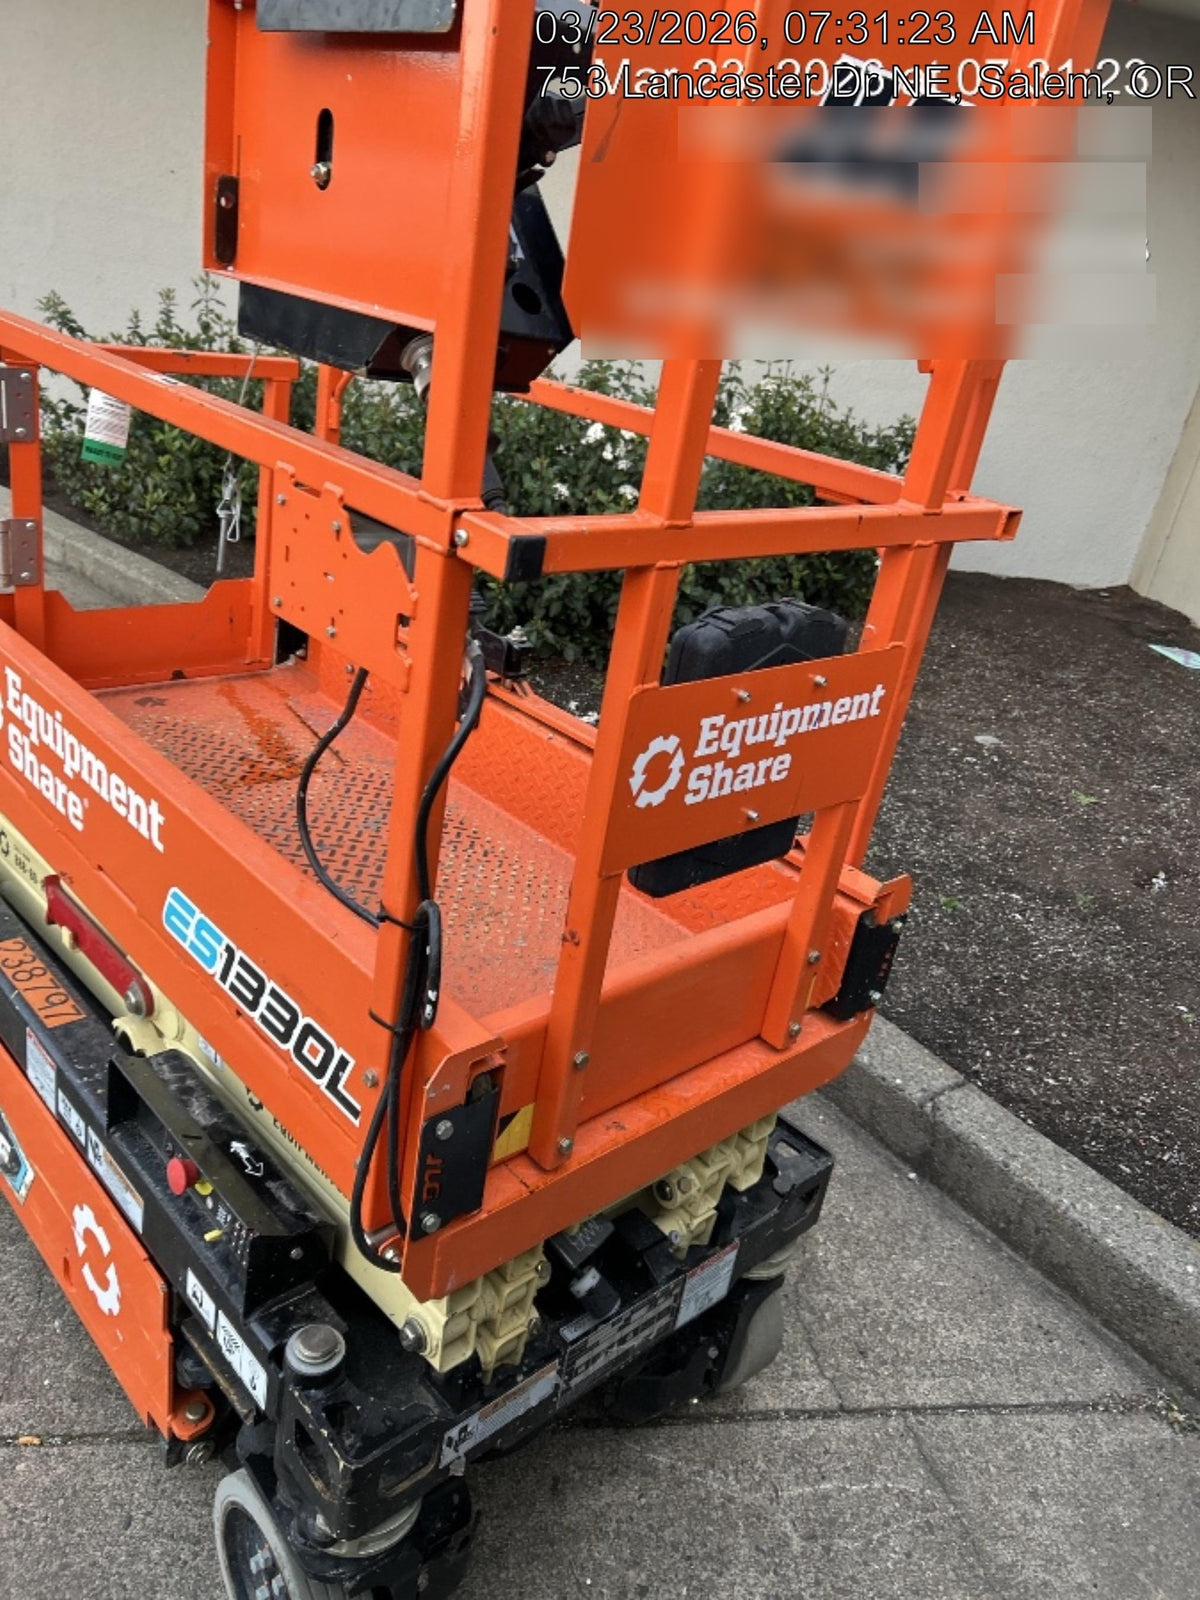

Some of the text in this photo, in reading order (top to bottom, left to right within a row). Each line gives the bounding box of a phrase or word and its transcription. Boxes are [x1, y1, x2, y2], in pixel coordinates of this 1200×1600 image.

[5, 666, 165, 854] Equipment
[693, 683, 886, 759] Equipment
[8, 723, 84, 832] Share
[684, 752, 792, 806] Share
[163, 886, 363, 1127] ES1330L
